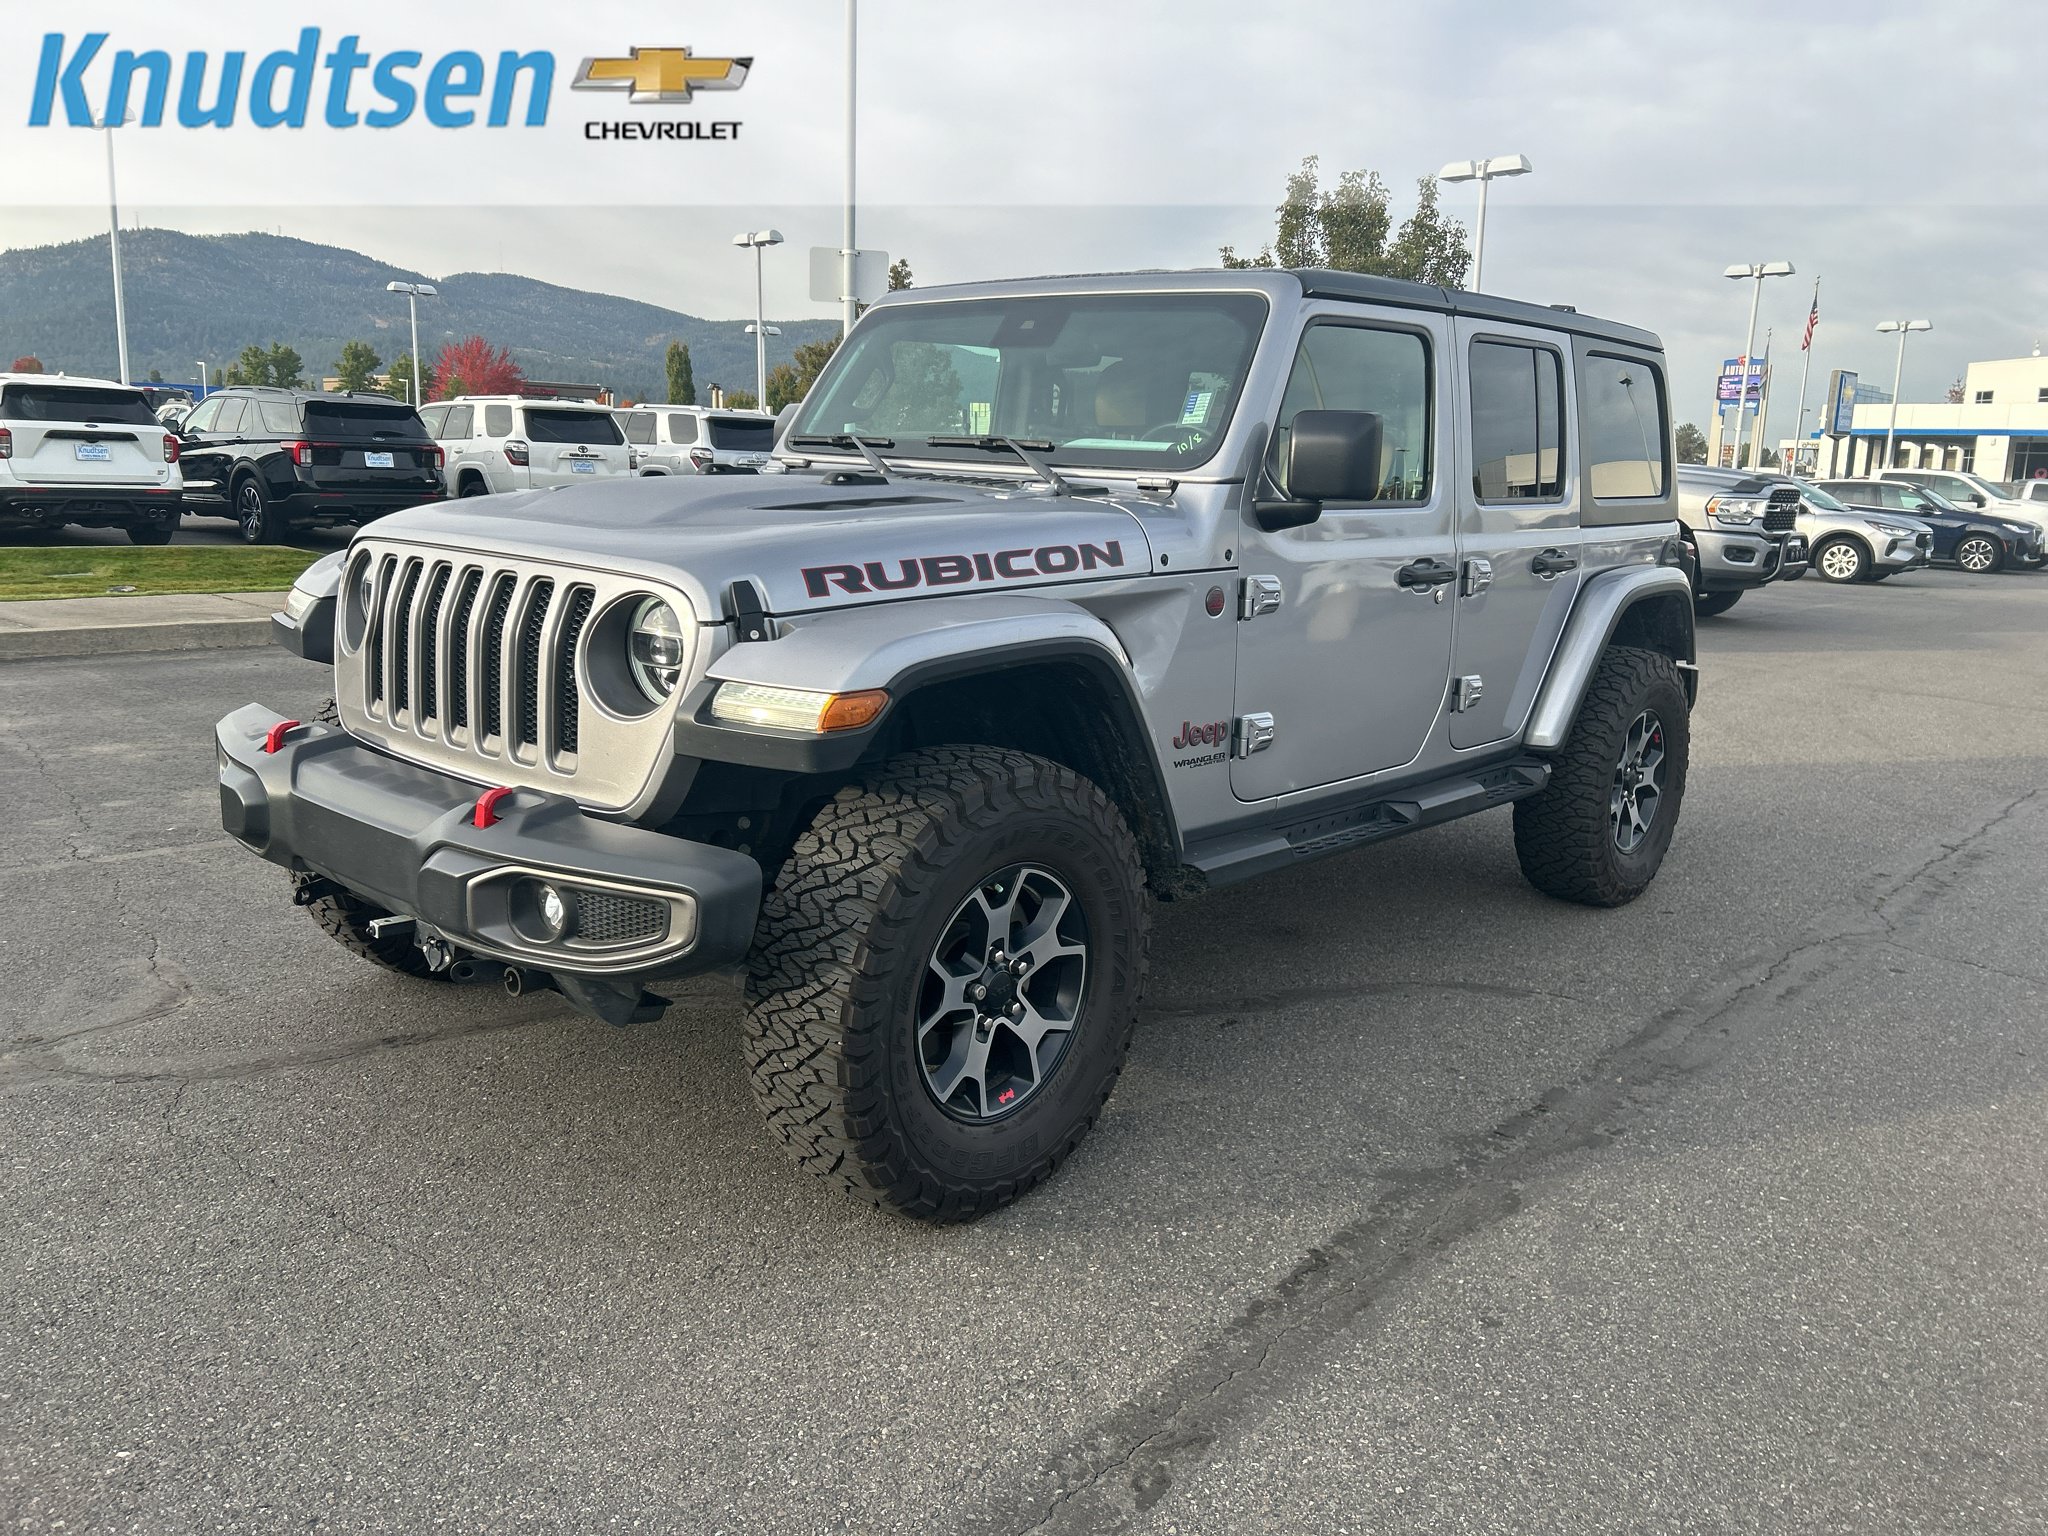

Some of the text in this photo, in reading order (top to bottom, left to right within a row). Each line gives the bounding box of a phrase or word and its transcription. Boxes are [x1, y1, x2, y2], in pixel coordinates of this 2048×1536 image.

[1724, 365, 1762, 376] AUTOLEX
[78, 446, 108, 454] Knudtsen
[801, 541, 1125, 599] RUBICON
[1172, 719, 1229, 750] Jeep
[1173, 752, 1226, 768] WRANGLER
[1189, 758, 1226, 769] UNLIMITED
